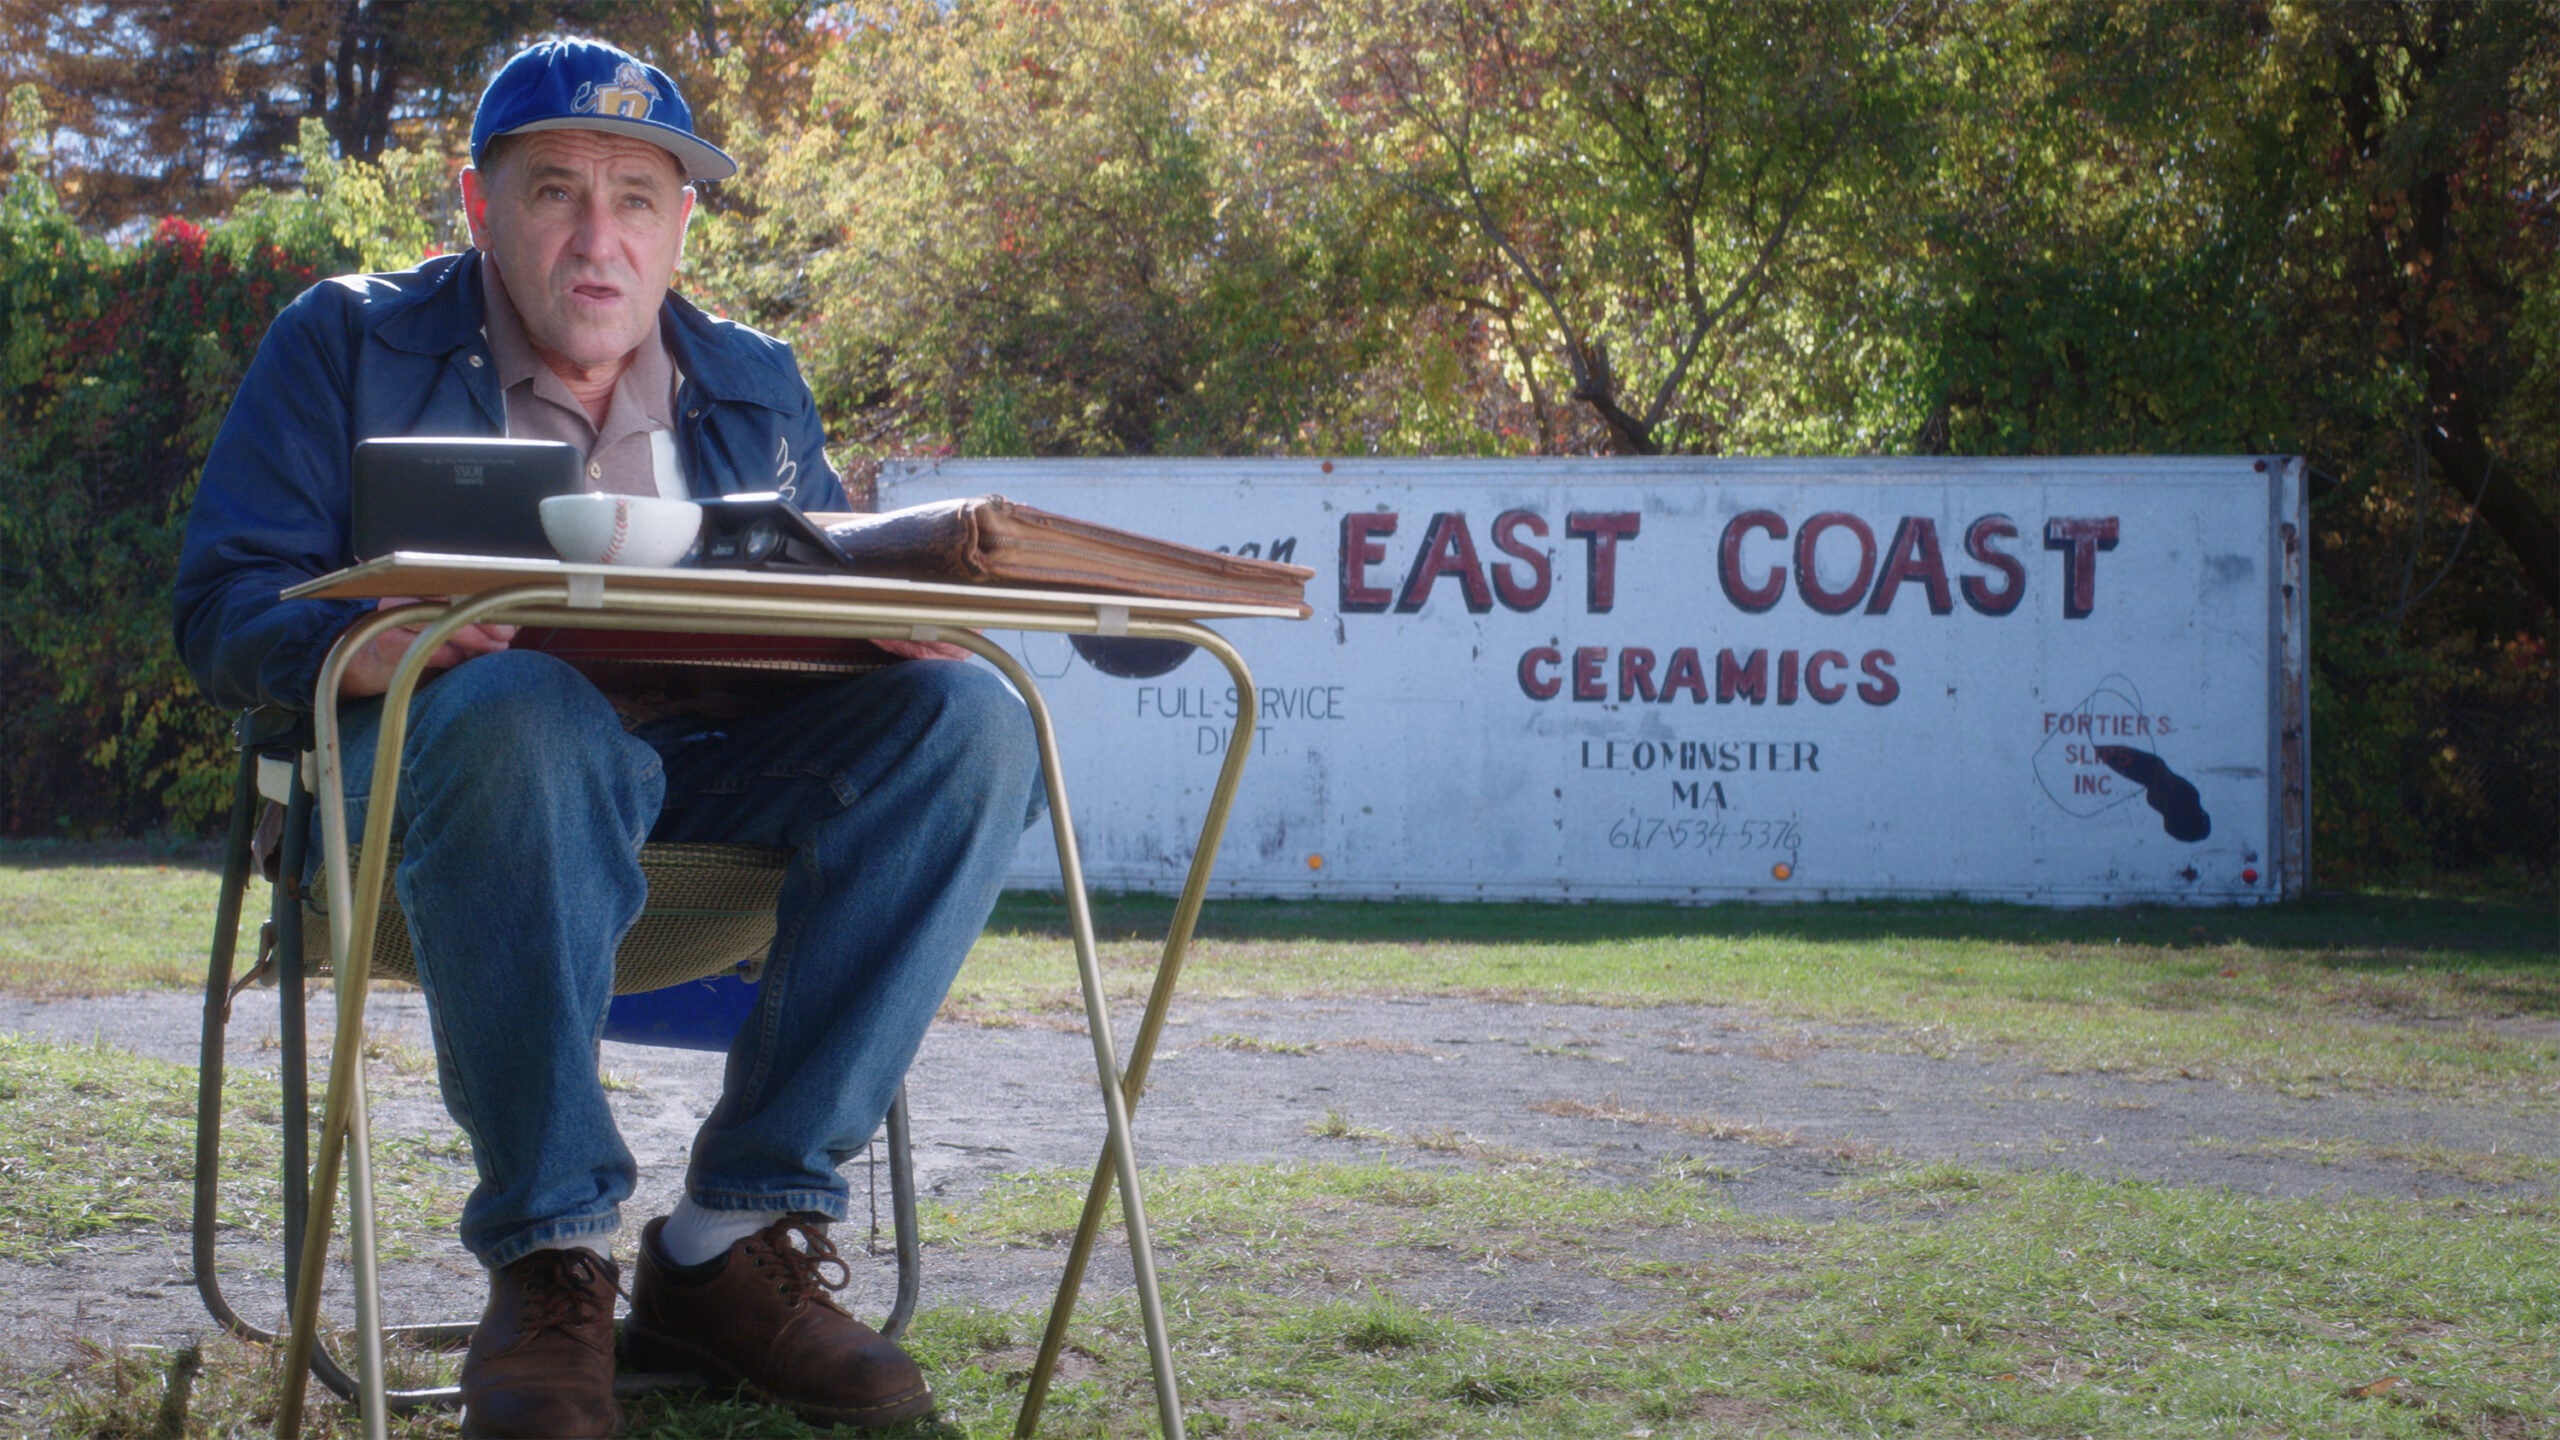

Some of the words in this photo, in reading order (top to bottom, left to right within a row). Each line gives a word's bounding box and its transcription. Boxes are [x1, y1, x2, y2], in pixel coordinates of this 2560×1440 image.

[1339, 509, 1641, 614] EAST
[1718, 510, 2119, 619] COAST
[1517, 646, 1900, 706] CERAMICS
[1137, 686, 1345, 719] FULL-SRVICE
[1581, 740, 1821, 772] LEOMINSTER
